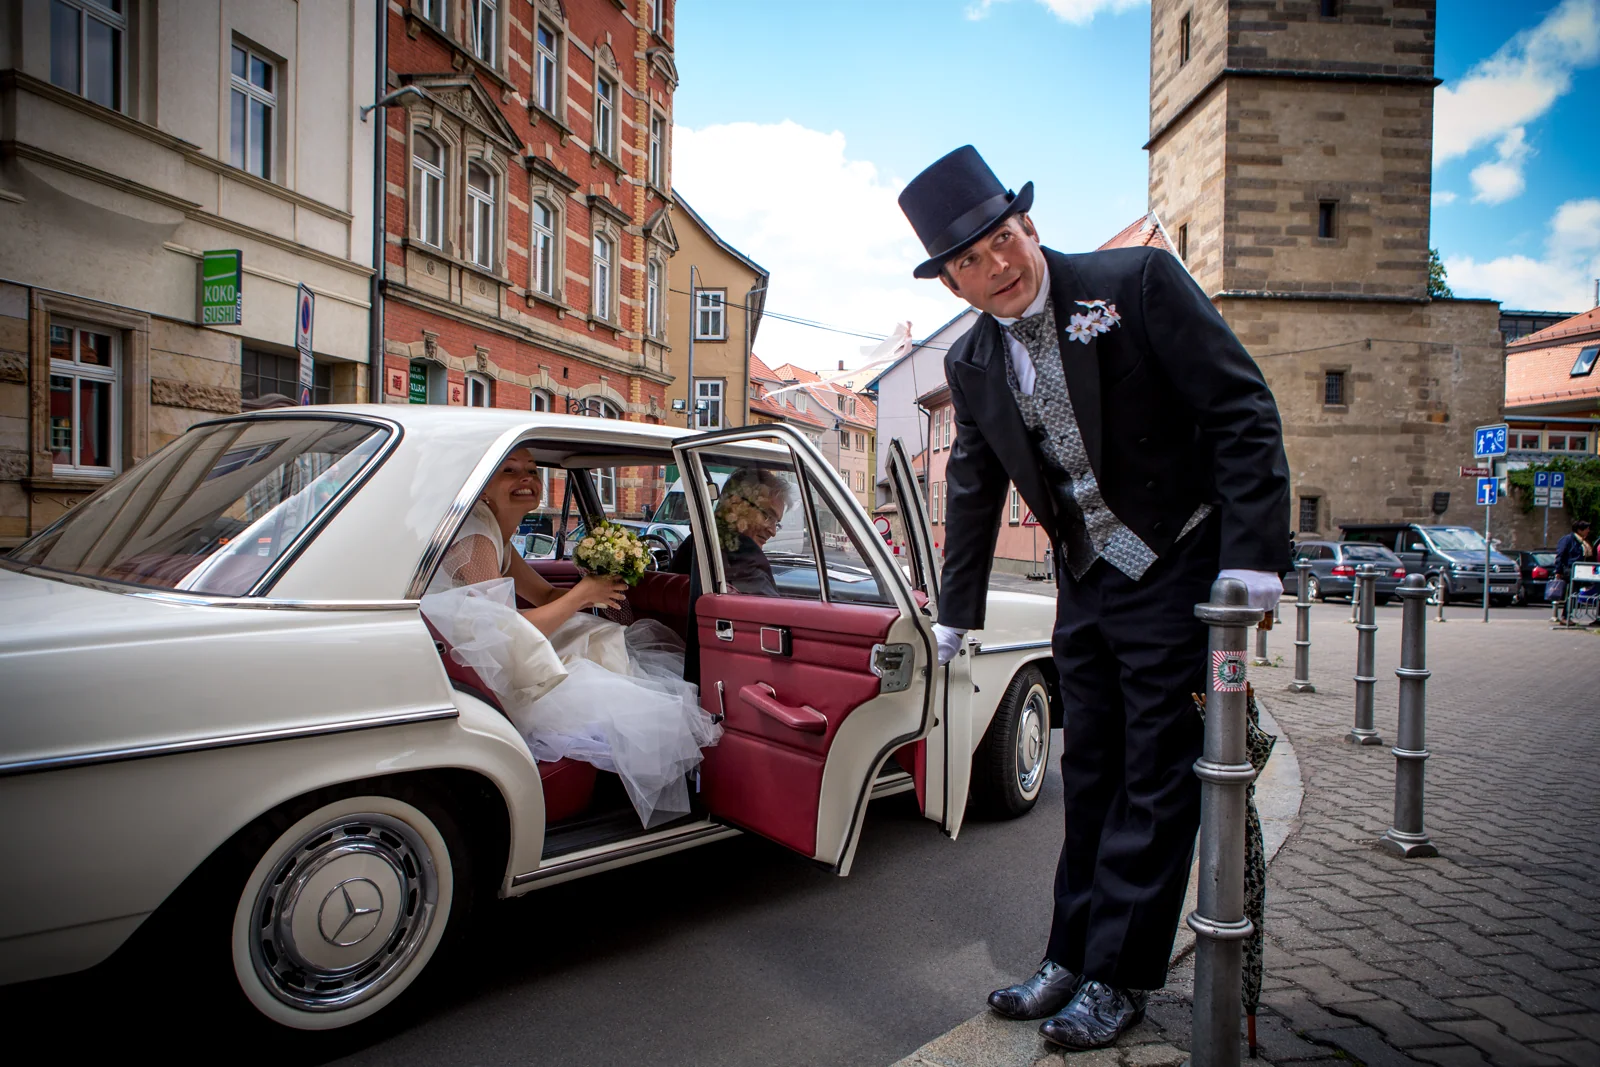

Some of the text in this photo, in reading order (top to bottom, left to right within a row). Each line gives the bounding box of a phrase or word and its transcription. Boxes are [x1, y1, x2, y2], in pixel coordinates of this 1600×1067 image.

[204, 285, 235, 302] KOKO
[203, 306, 236, 323] SUSHI
[1537, 473, 1546, 486] P
[1553, 474, 1562, 486] P
